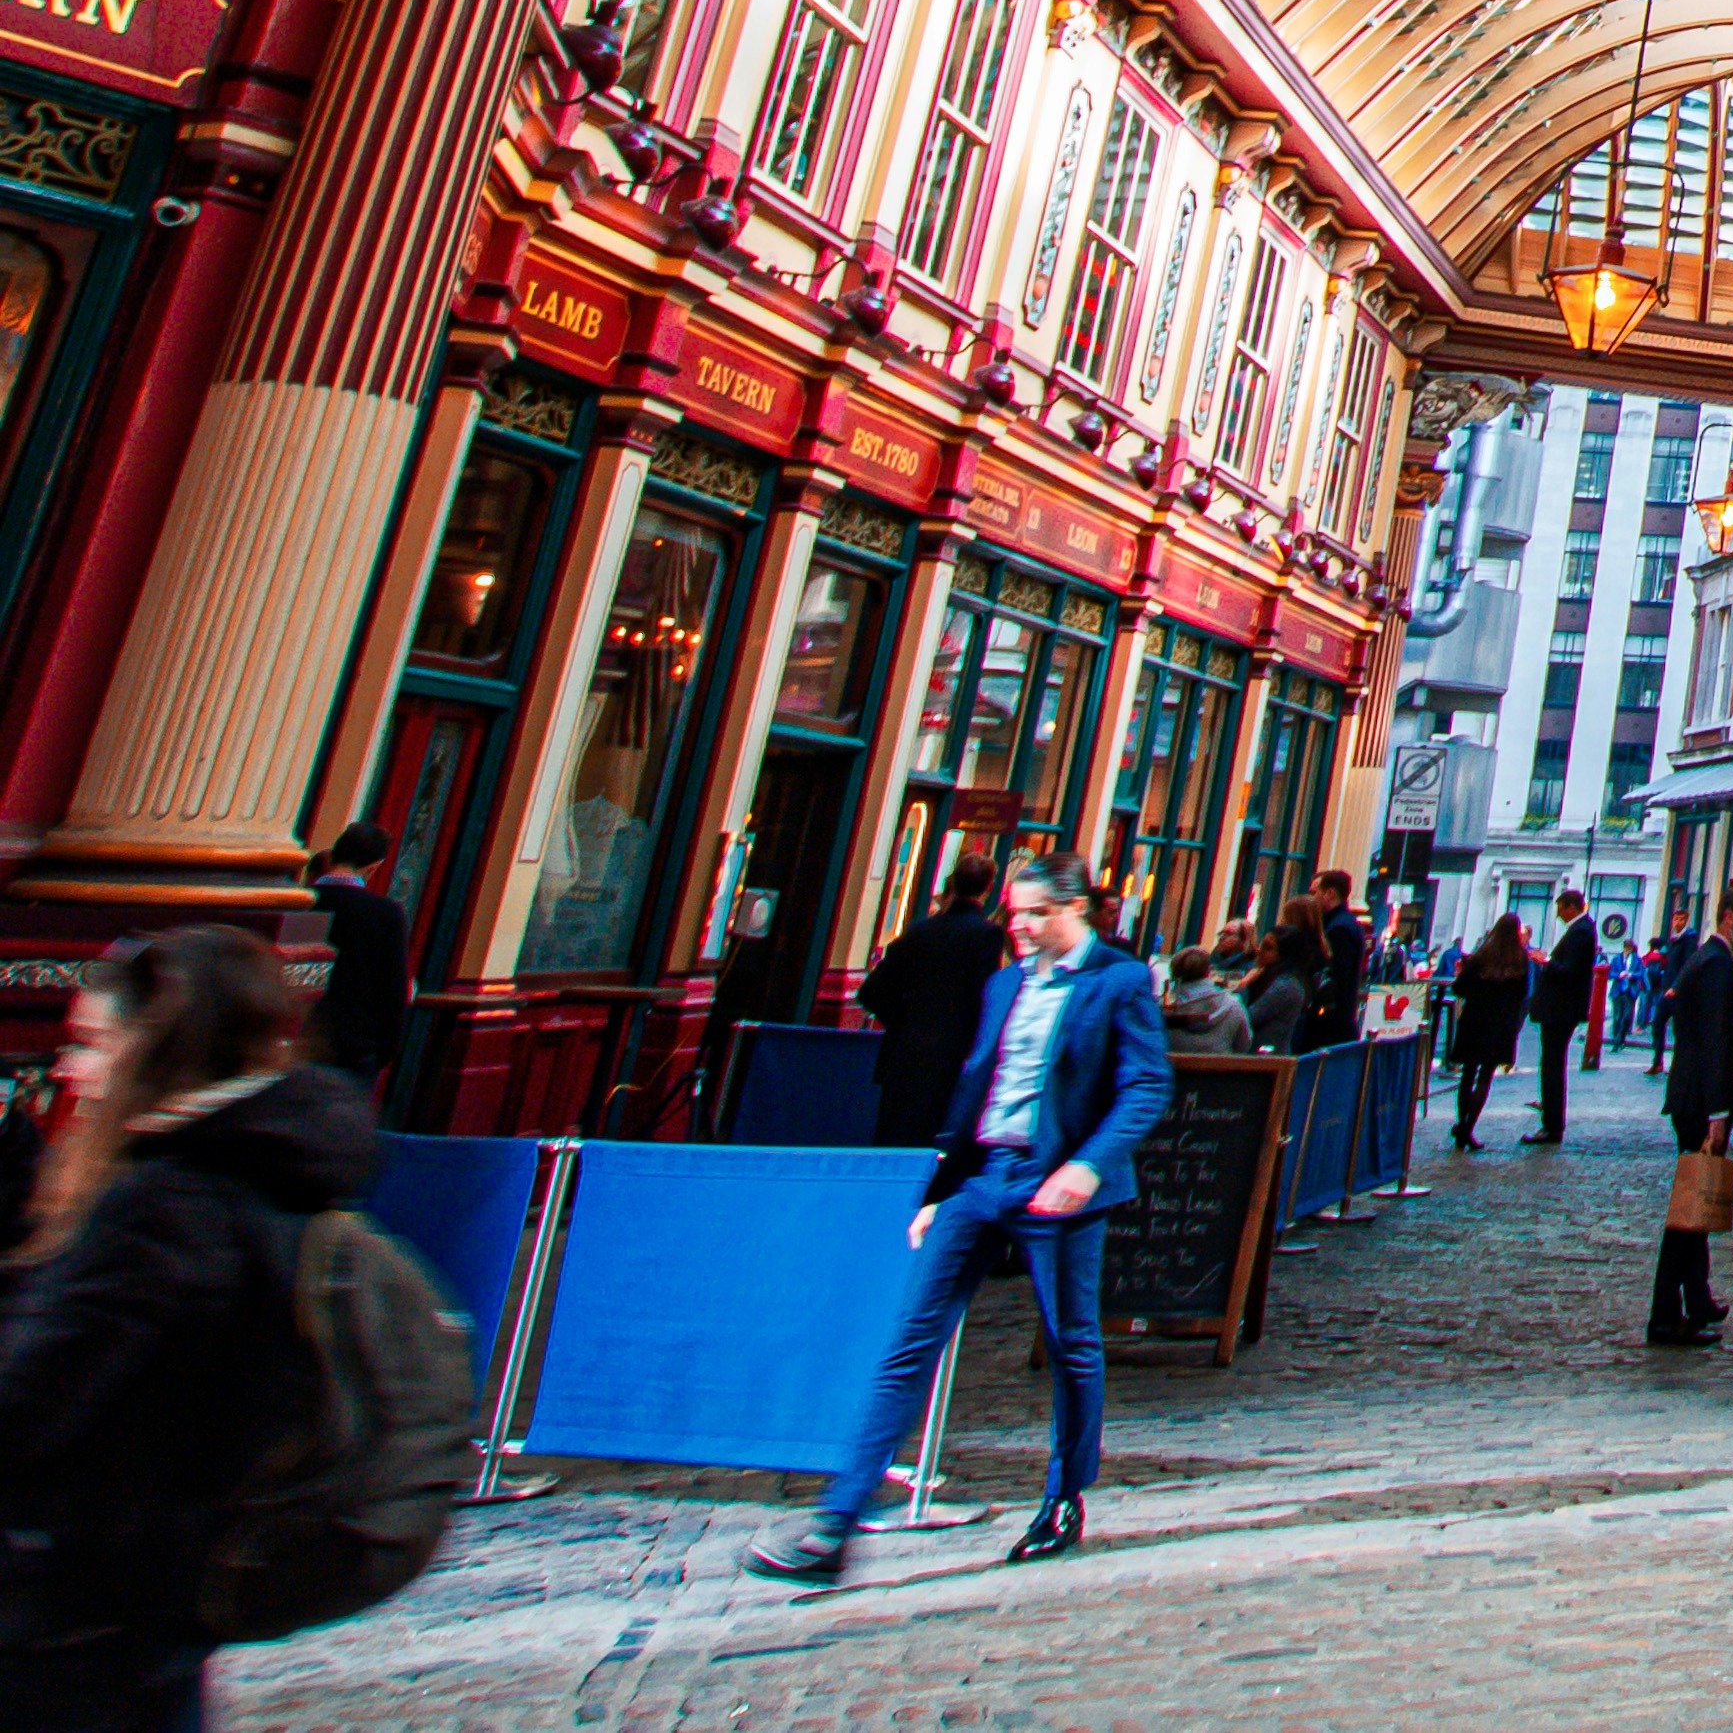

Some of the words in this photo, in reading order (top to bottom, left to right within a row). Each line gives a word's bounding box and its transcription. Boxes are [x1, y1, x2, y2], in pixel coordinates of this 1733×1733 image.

[521, 281, 603, 340] LAMB
[697, 356, 776, 414] TAVERN
[851, 427, 919, 477] EST.1780
[1066, 522, 1098, 555] LEON
[1395, 814, 1431, 826] ENDS
